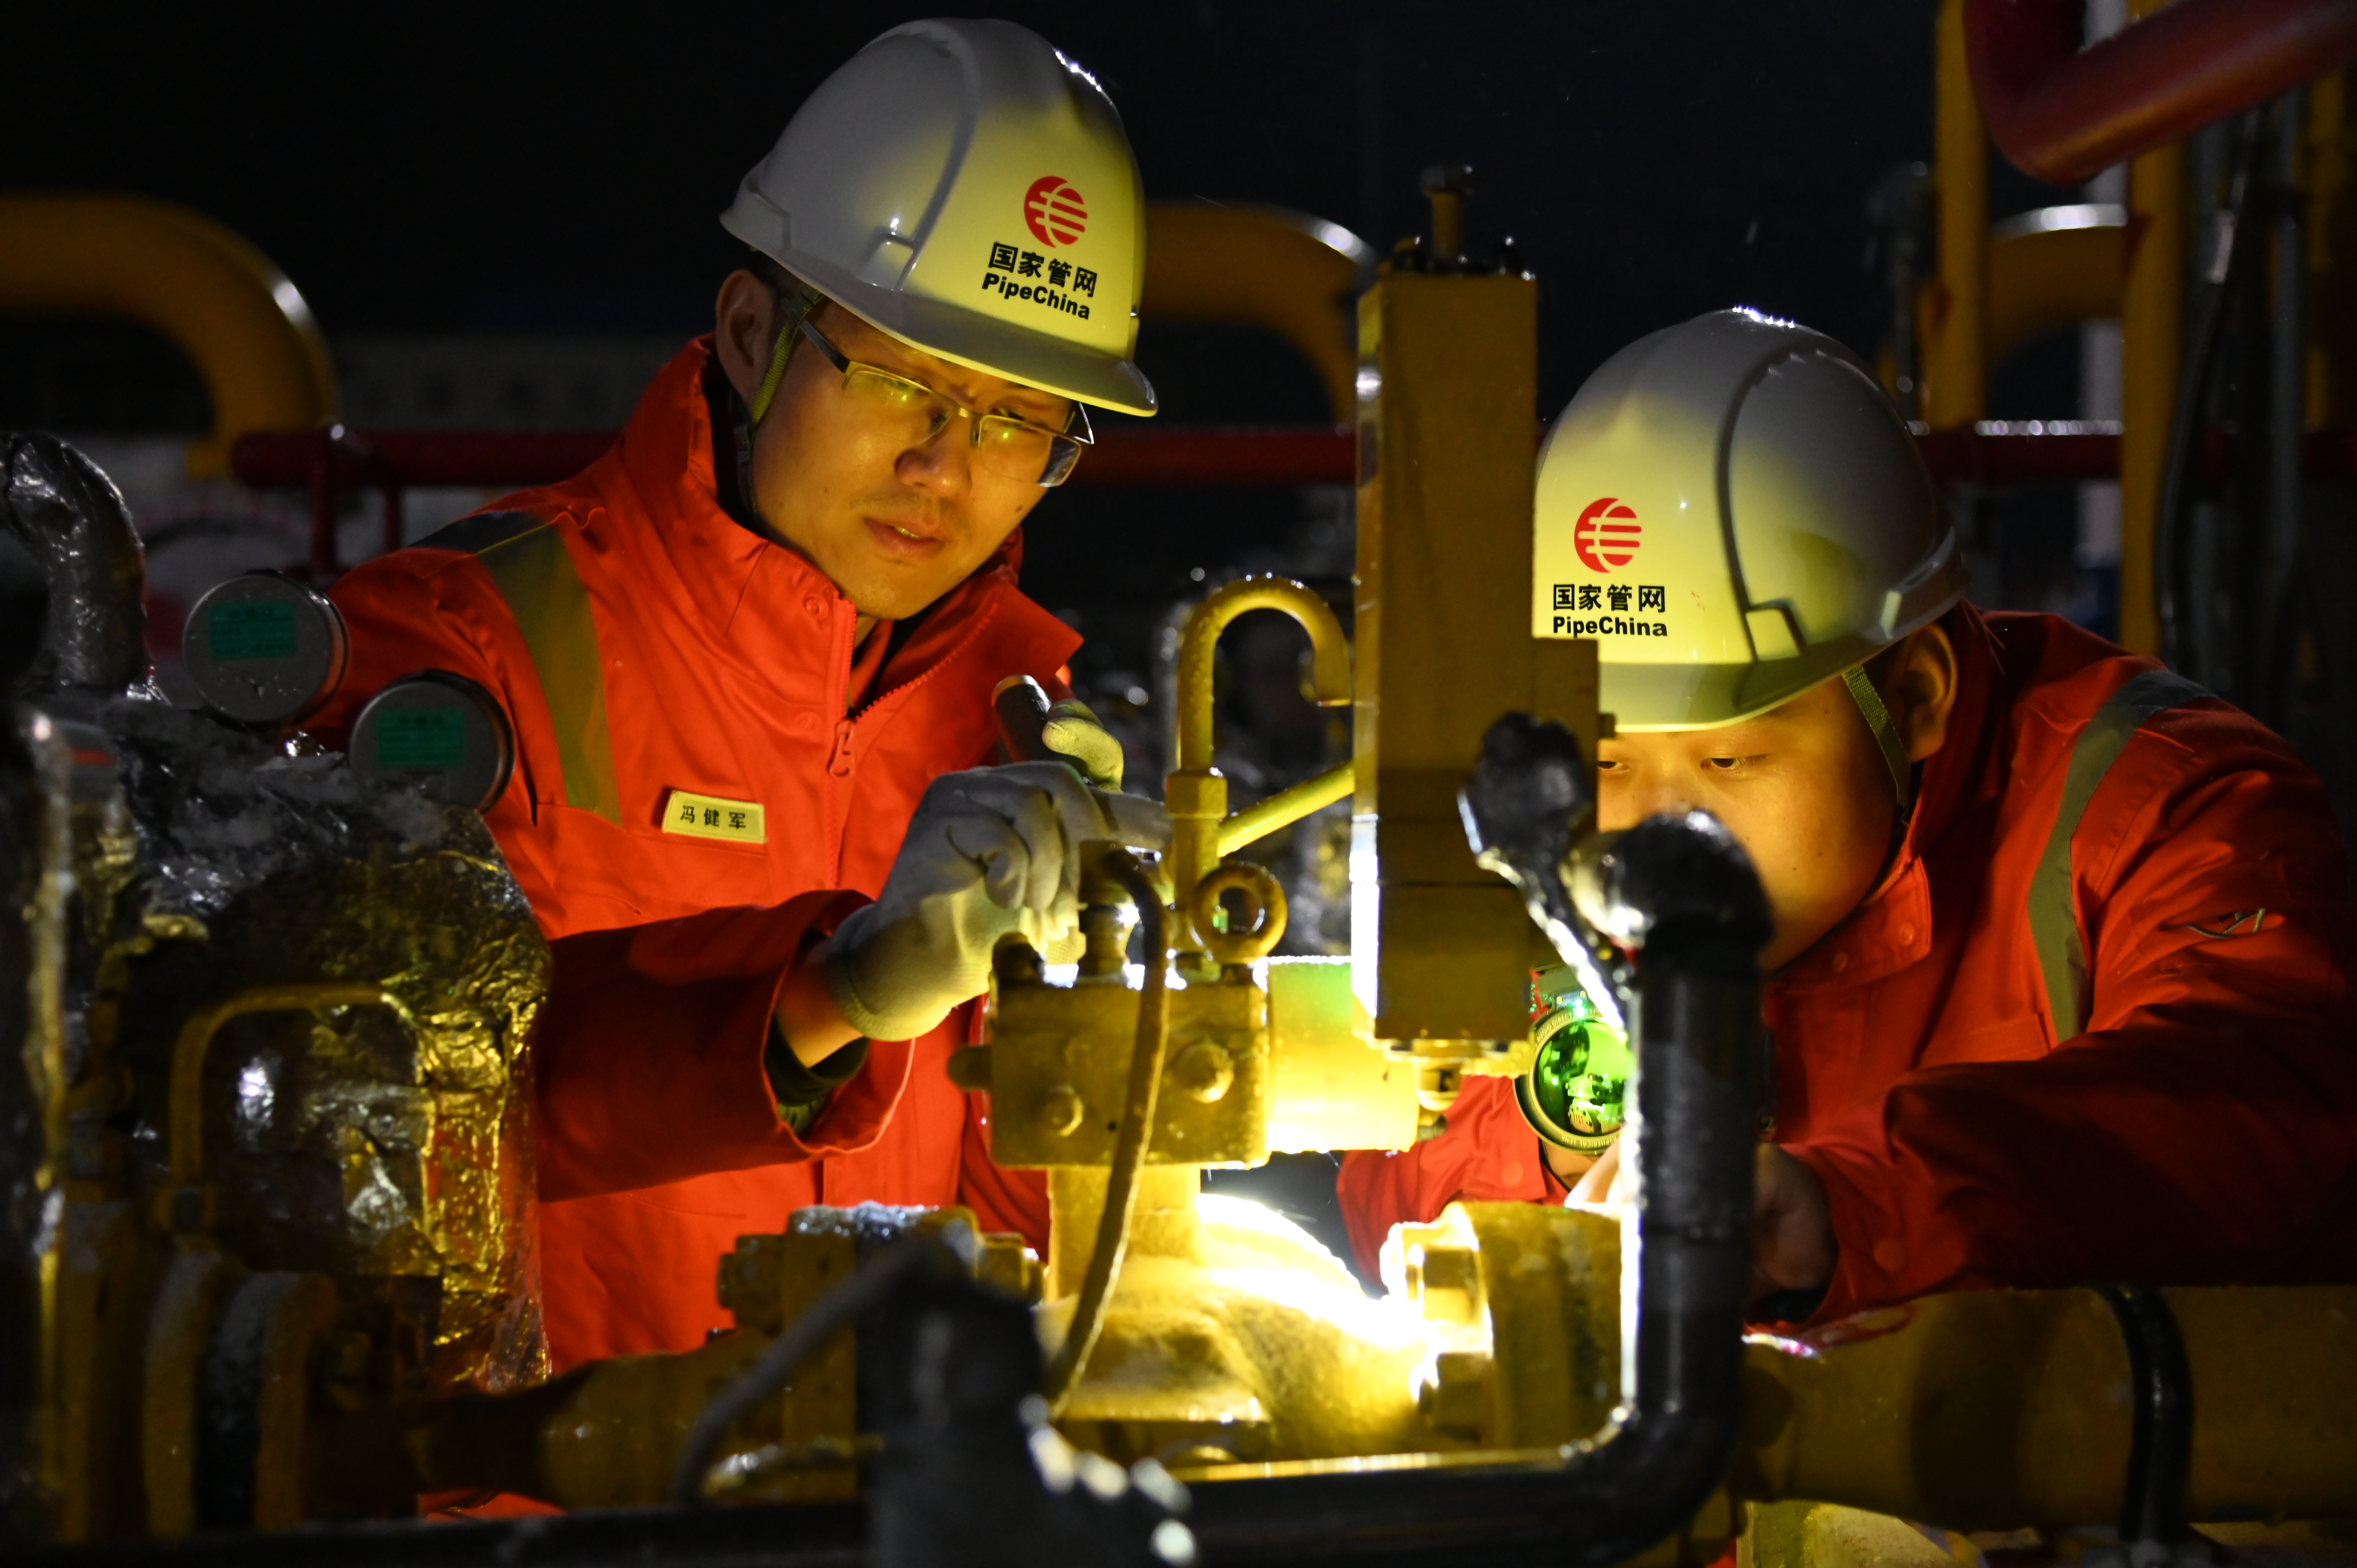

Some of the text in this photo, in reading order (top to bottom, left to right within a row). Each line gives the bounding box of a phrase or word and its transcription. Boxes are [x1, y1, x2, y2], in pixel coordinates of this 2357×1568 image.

[988, 242, 1097, 297] 国家管网
[982, 272, 1090, 320] PipeChina
[1553, 584, 1666, 613] 国家管网
[1553, 616, 1668, 638] PipeChina
[681, 805, 746, 829] 冯健军
[1552, 1011, 1572, 1027] DIRECT
[1562, 1135, 1576, 1146] LENS
